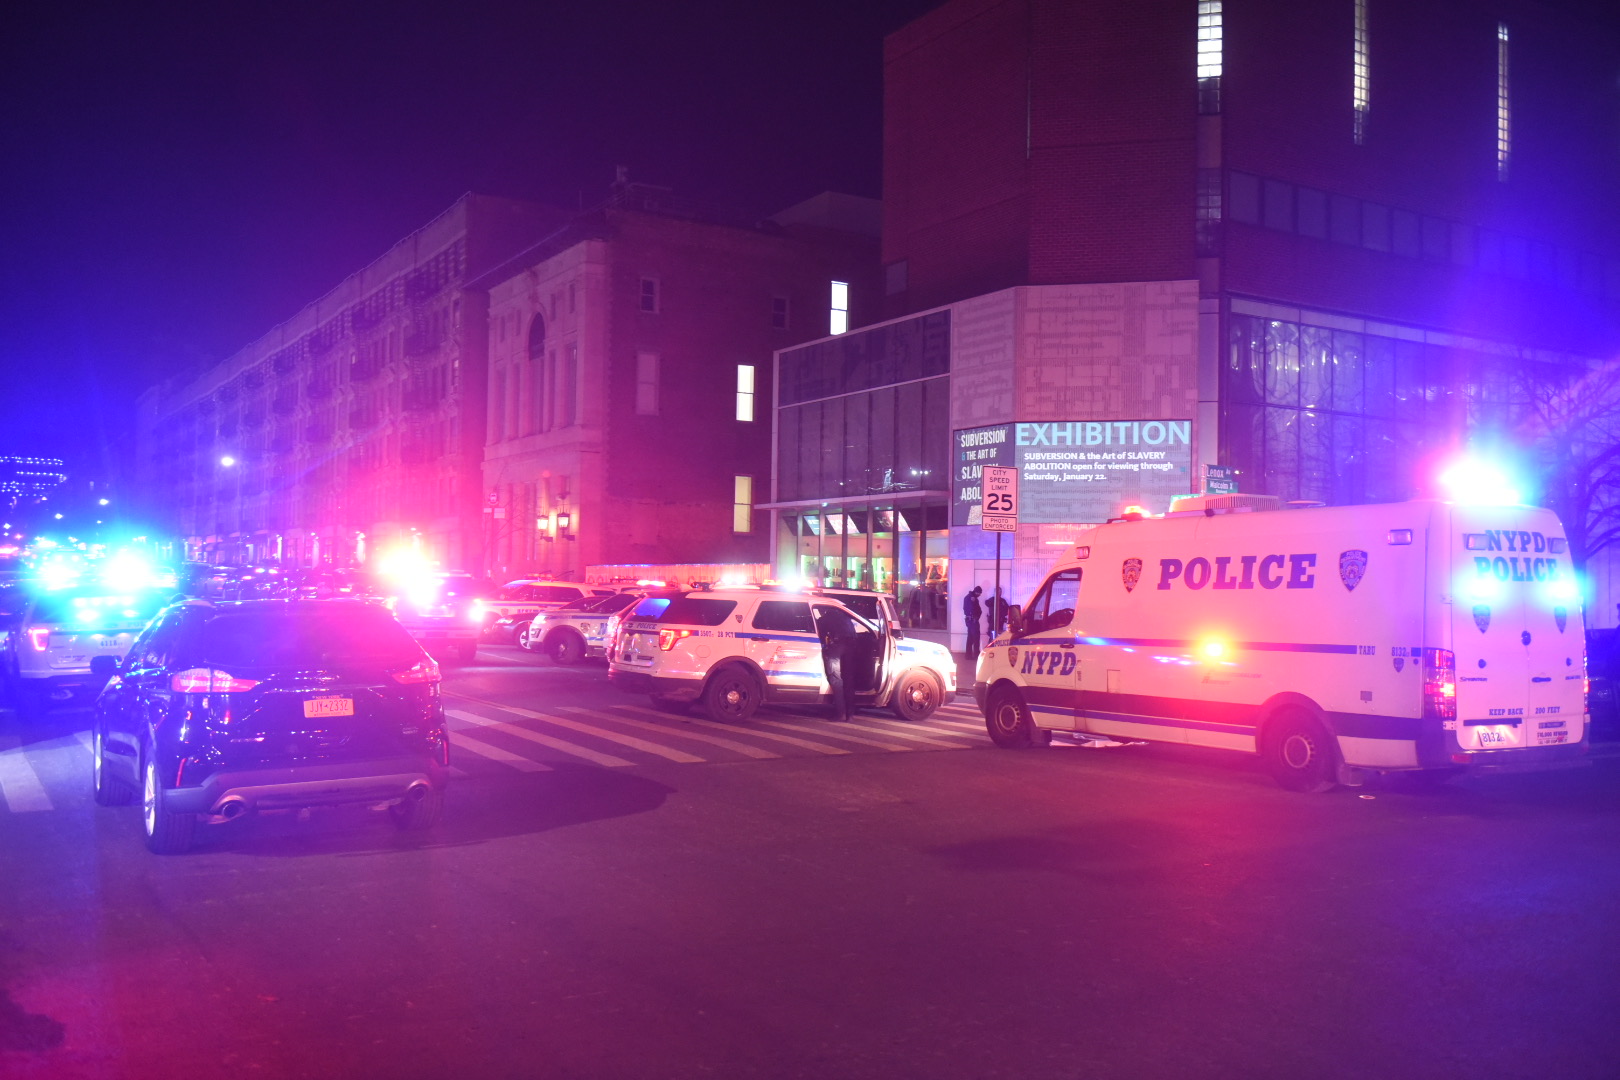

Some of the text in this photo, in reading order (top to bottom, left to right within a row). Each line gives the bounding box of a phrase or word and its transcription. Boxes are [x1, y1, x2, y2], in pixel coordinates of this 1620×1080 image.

[960, 429, 1006, 447] SUBVERSION
[1015, 421, 1190, 446] EXHIBITION
[966, 451, 976, 460] THE
[977, 449, 988, 460] ART
[989, 447, 997, 458] OF
[1024, 451, 1166, 460] SUBVERSION & the Art of SLAVERY
[1024, 462, 1173, 472] ABOLITION open for viewing through
[1206, 465, 1224, 478] Lenox
[1024, 473, 1062, 482] Saturday,
[1063, 473, 1093, 482] January
[986, 493, 1013, 511] 25
[1484, 529, 1546, 553] NYPD
[1157, 553, 1317, 591] POLICE
[1473, 556, 1558, 582] POLICE
[636, 622, 658, 630] POLICE
[1358, 645, 1376, 656] TARU
[1020, 650, 1077, 676] NYPD
[1488, 708, 1506, 716] KEEP
[1547, 706, 1561, 714] FEET
